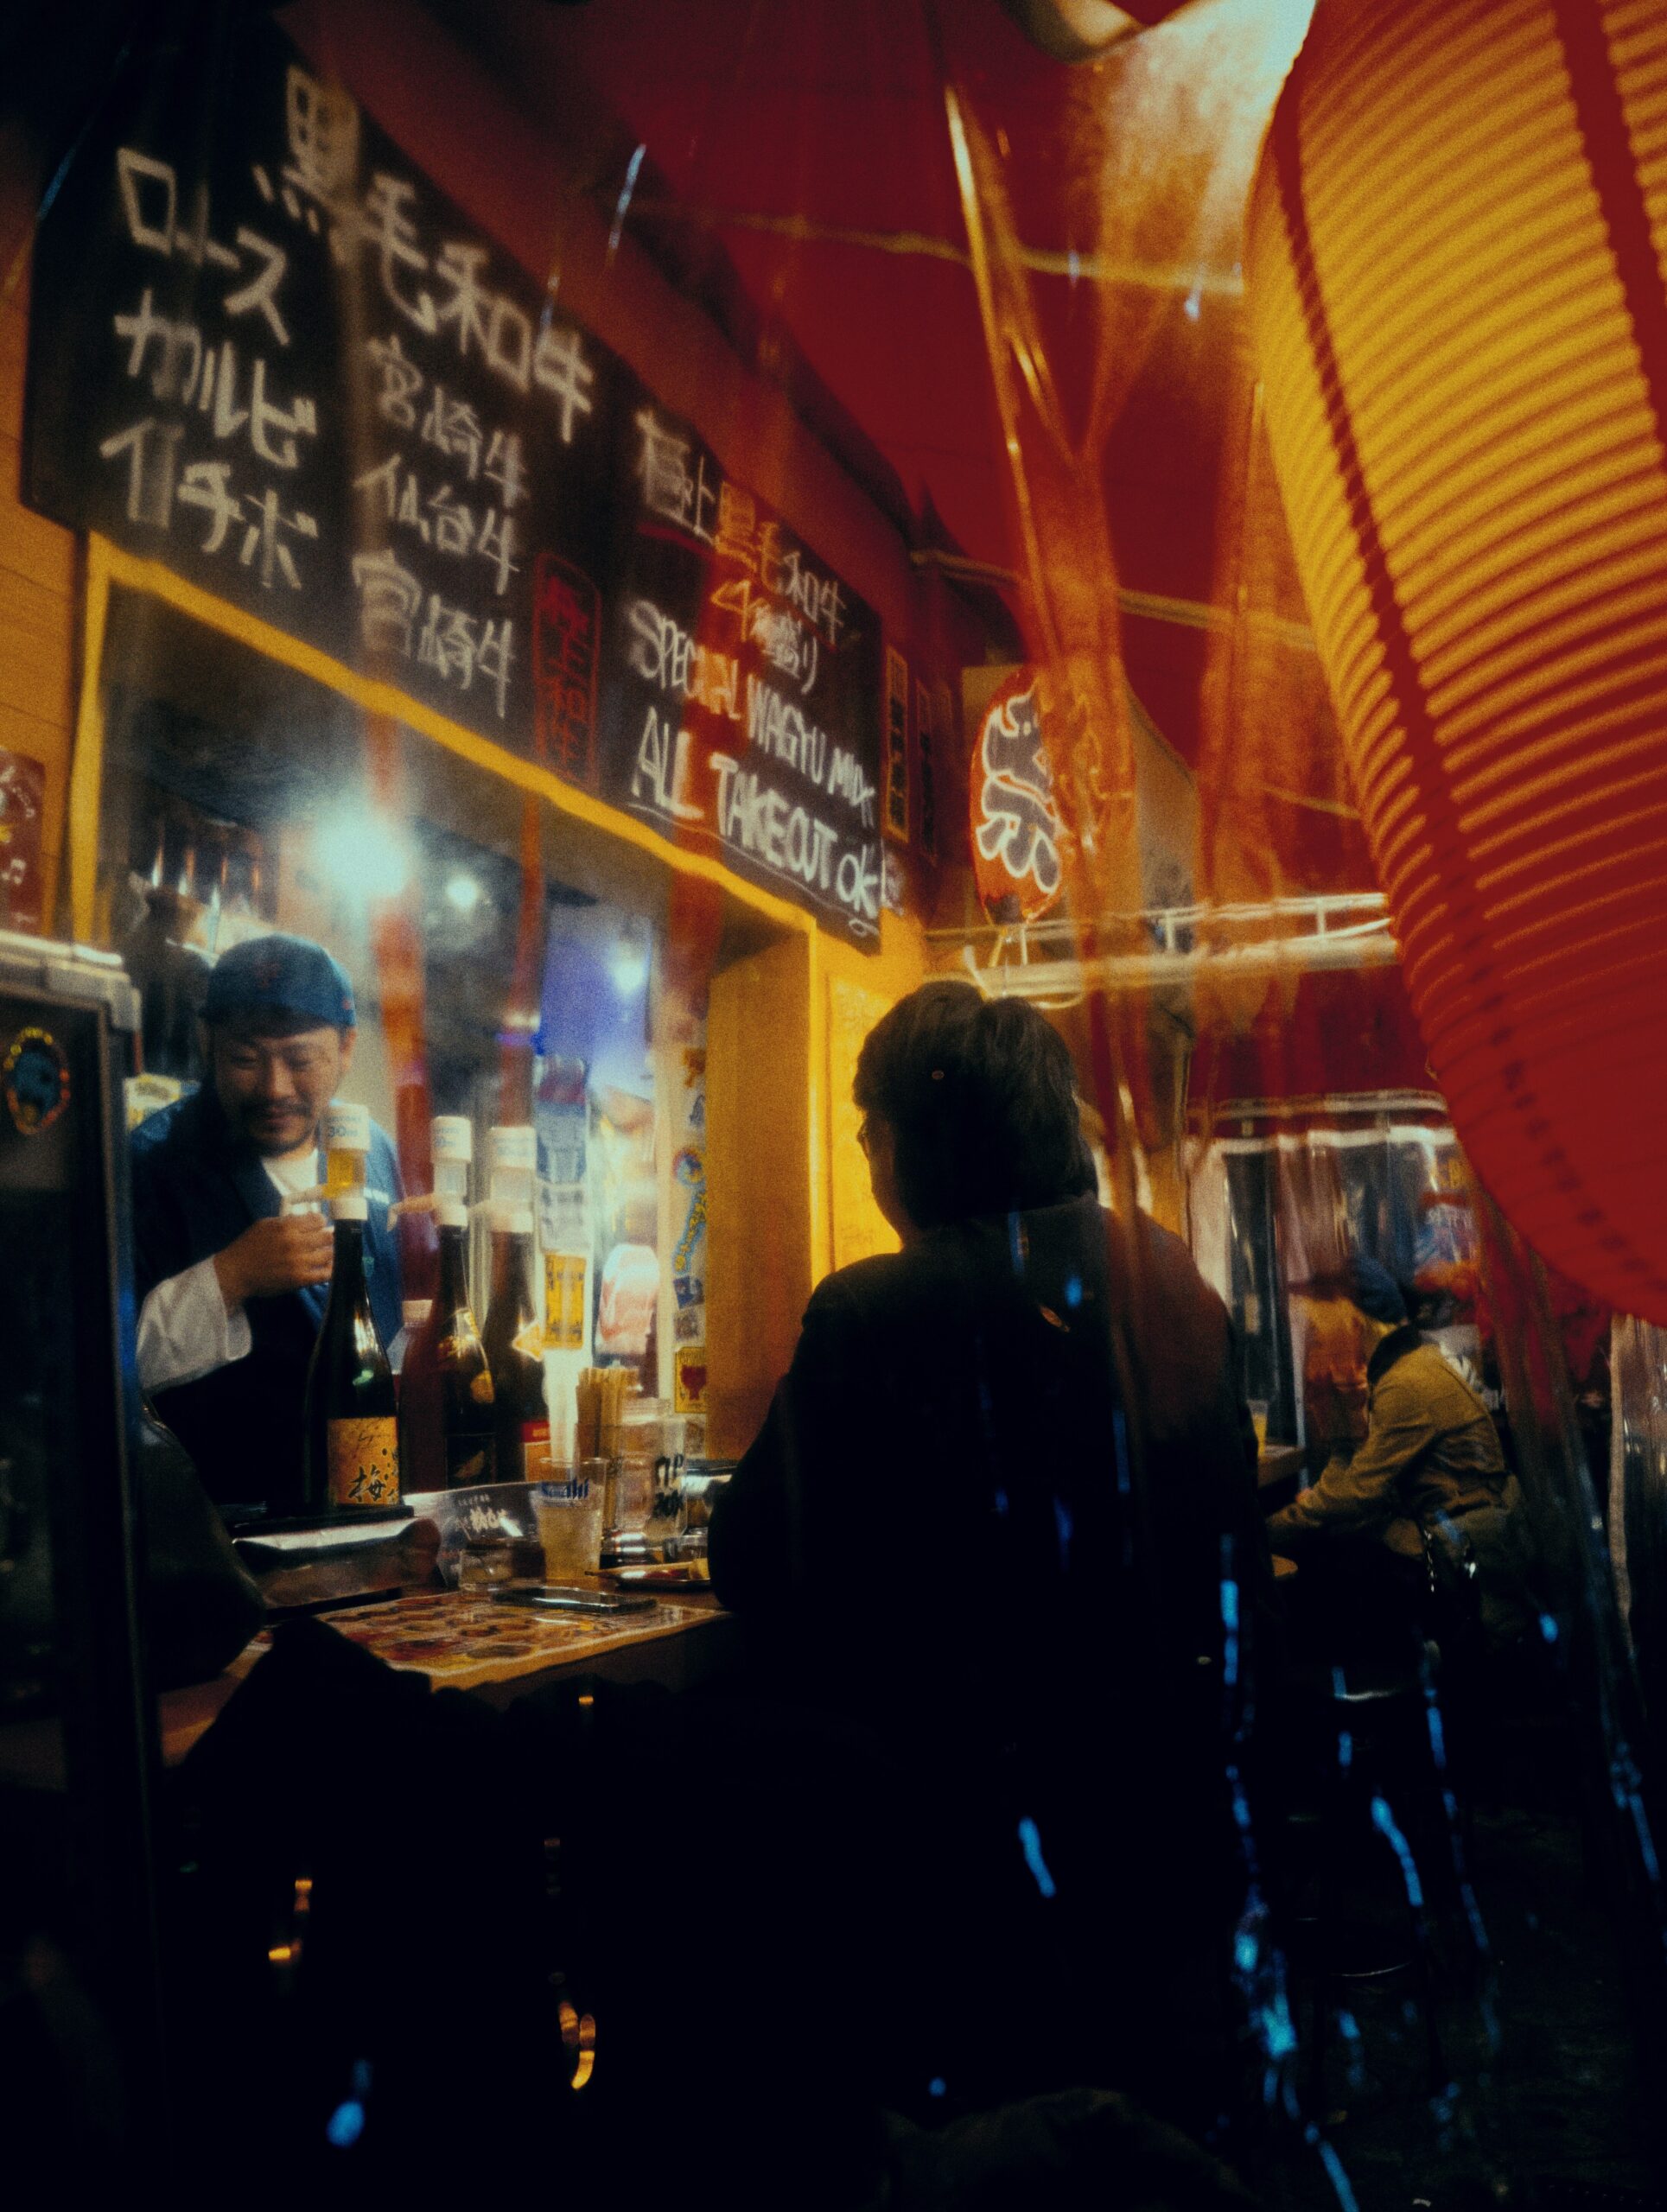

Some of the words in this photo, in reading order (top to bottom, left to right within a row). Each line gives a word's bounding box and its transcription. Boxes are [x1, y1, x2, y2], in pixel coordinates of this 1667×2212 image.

[117, 147, 288, 346] ロース
[253, 64, 595, 444] 黒毛和牛
[113, 288, 316, 470] カルビ
[99, 417, 319, 590] イチボ
[352, 452, 521, 596] 仙台牛
[628, 600, 742, 721] SPECIAL
[746, 672, 827, 785] WAGYU
[825, 747, 876, 831] MIX
[630, 705, 706, 821] ALL
[708, 751, 839, 892] TAKEOUT
[837, 842, 880, 921] OK
